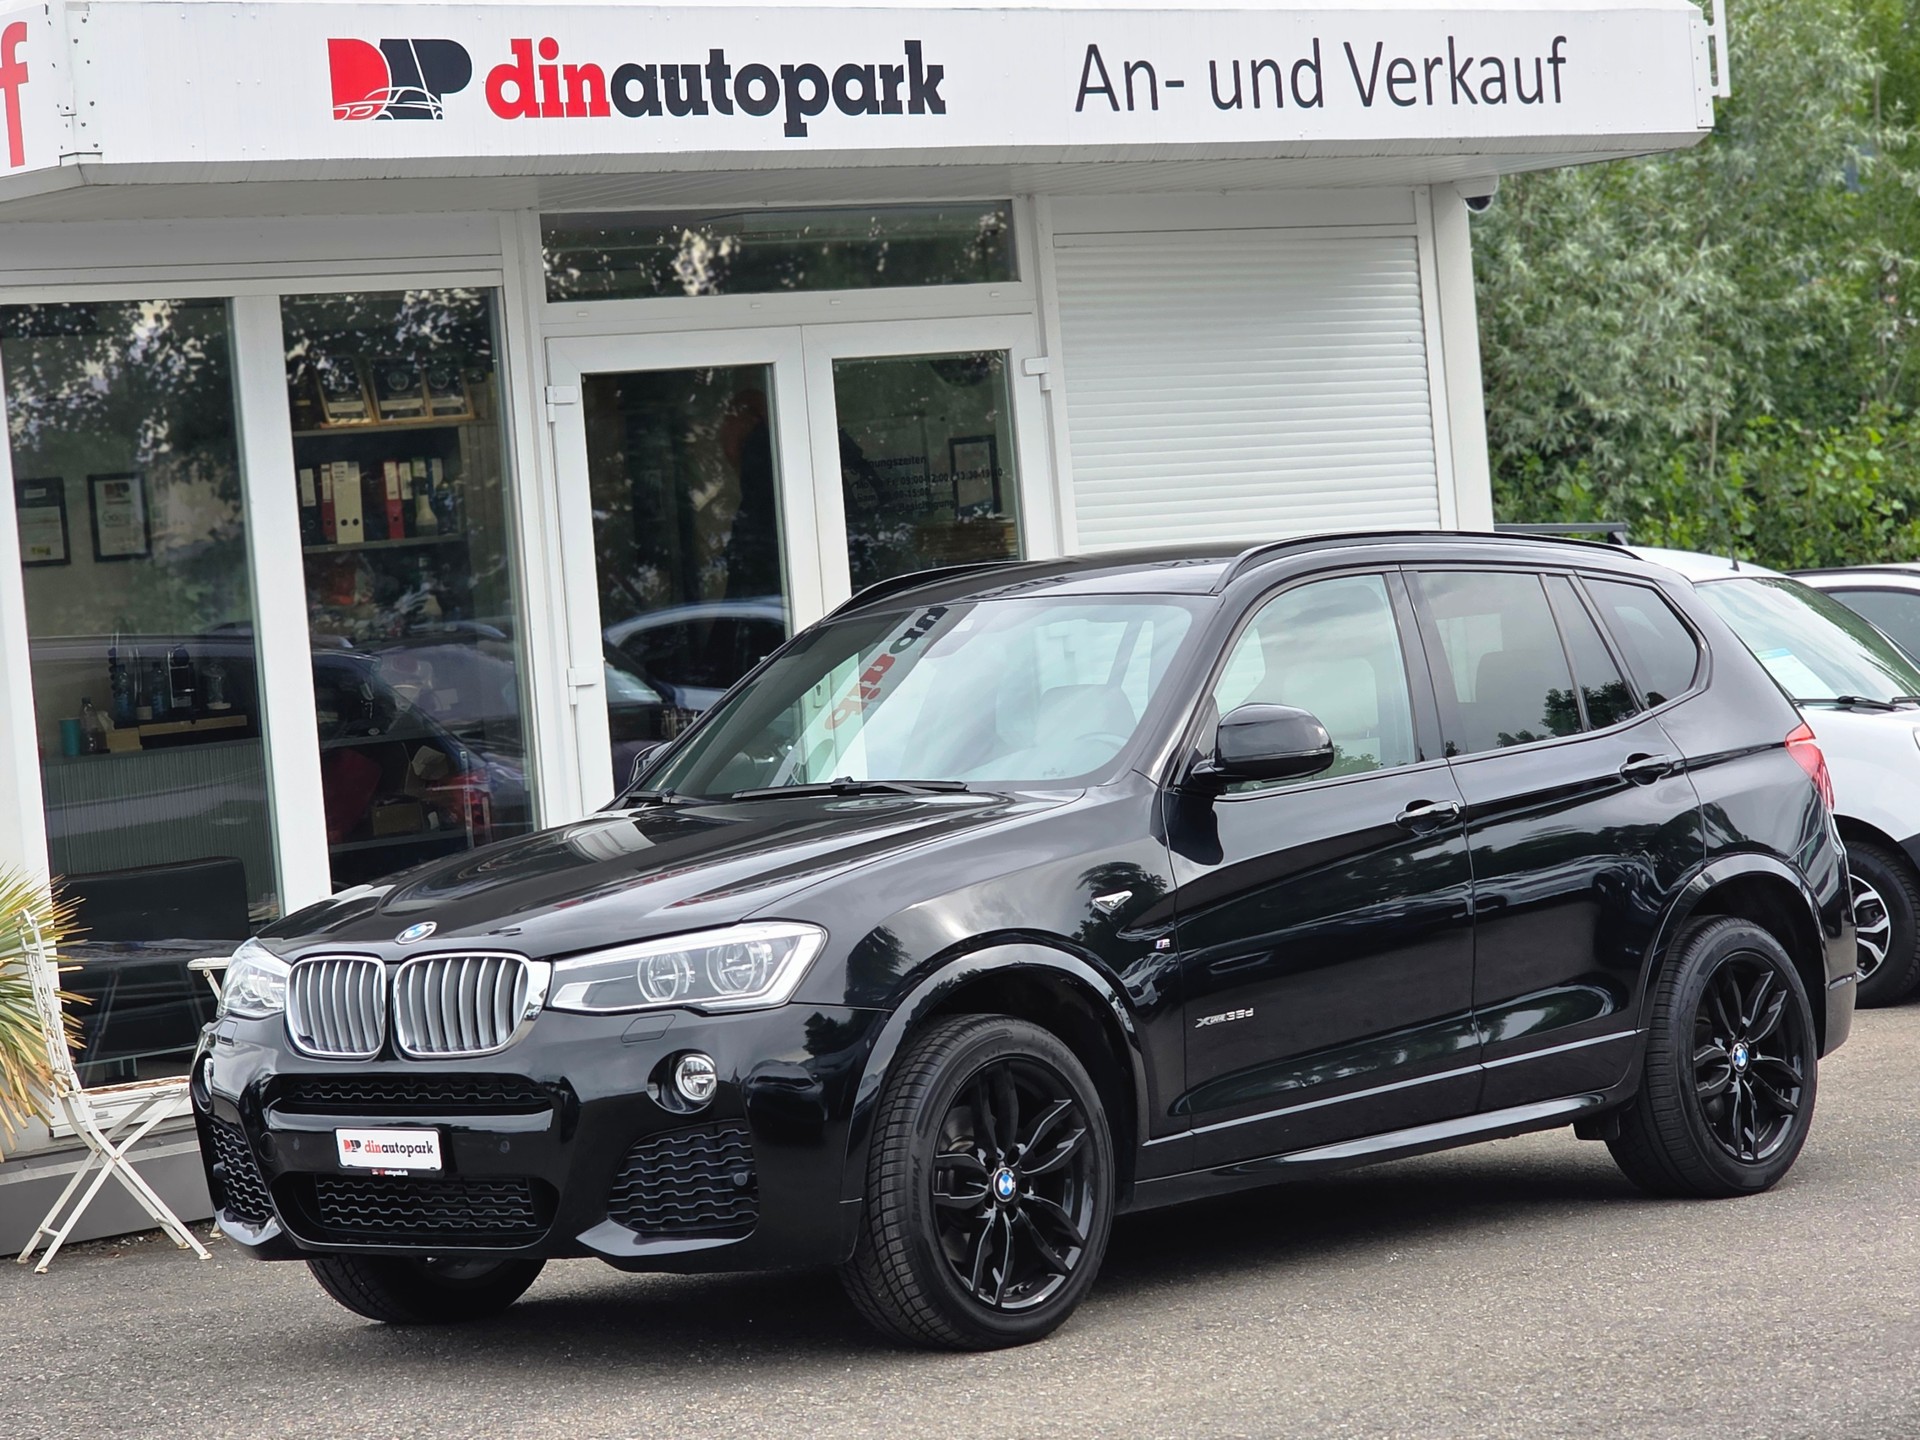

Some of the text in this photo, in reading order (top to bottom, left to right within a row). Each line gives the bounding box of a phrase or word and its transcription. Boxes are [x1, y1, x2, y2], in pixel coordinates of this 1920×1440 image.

[484, 36, 947, 138] dinautopark
[1075, 35, 1567, 112] An- und Verkauf
[364, 1139, 434, 1158] dinautopark
